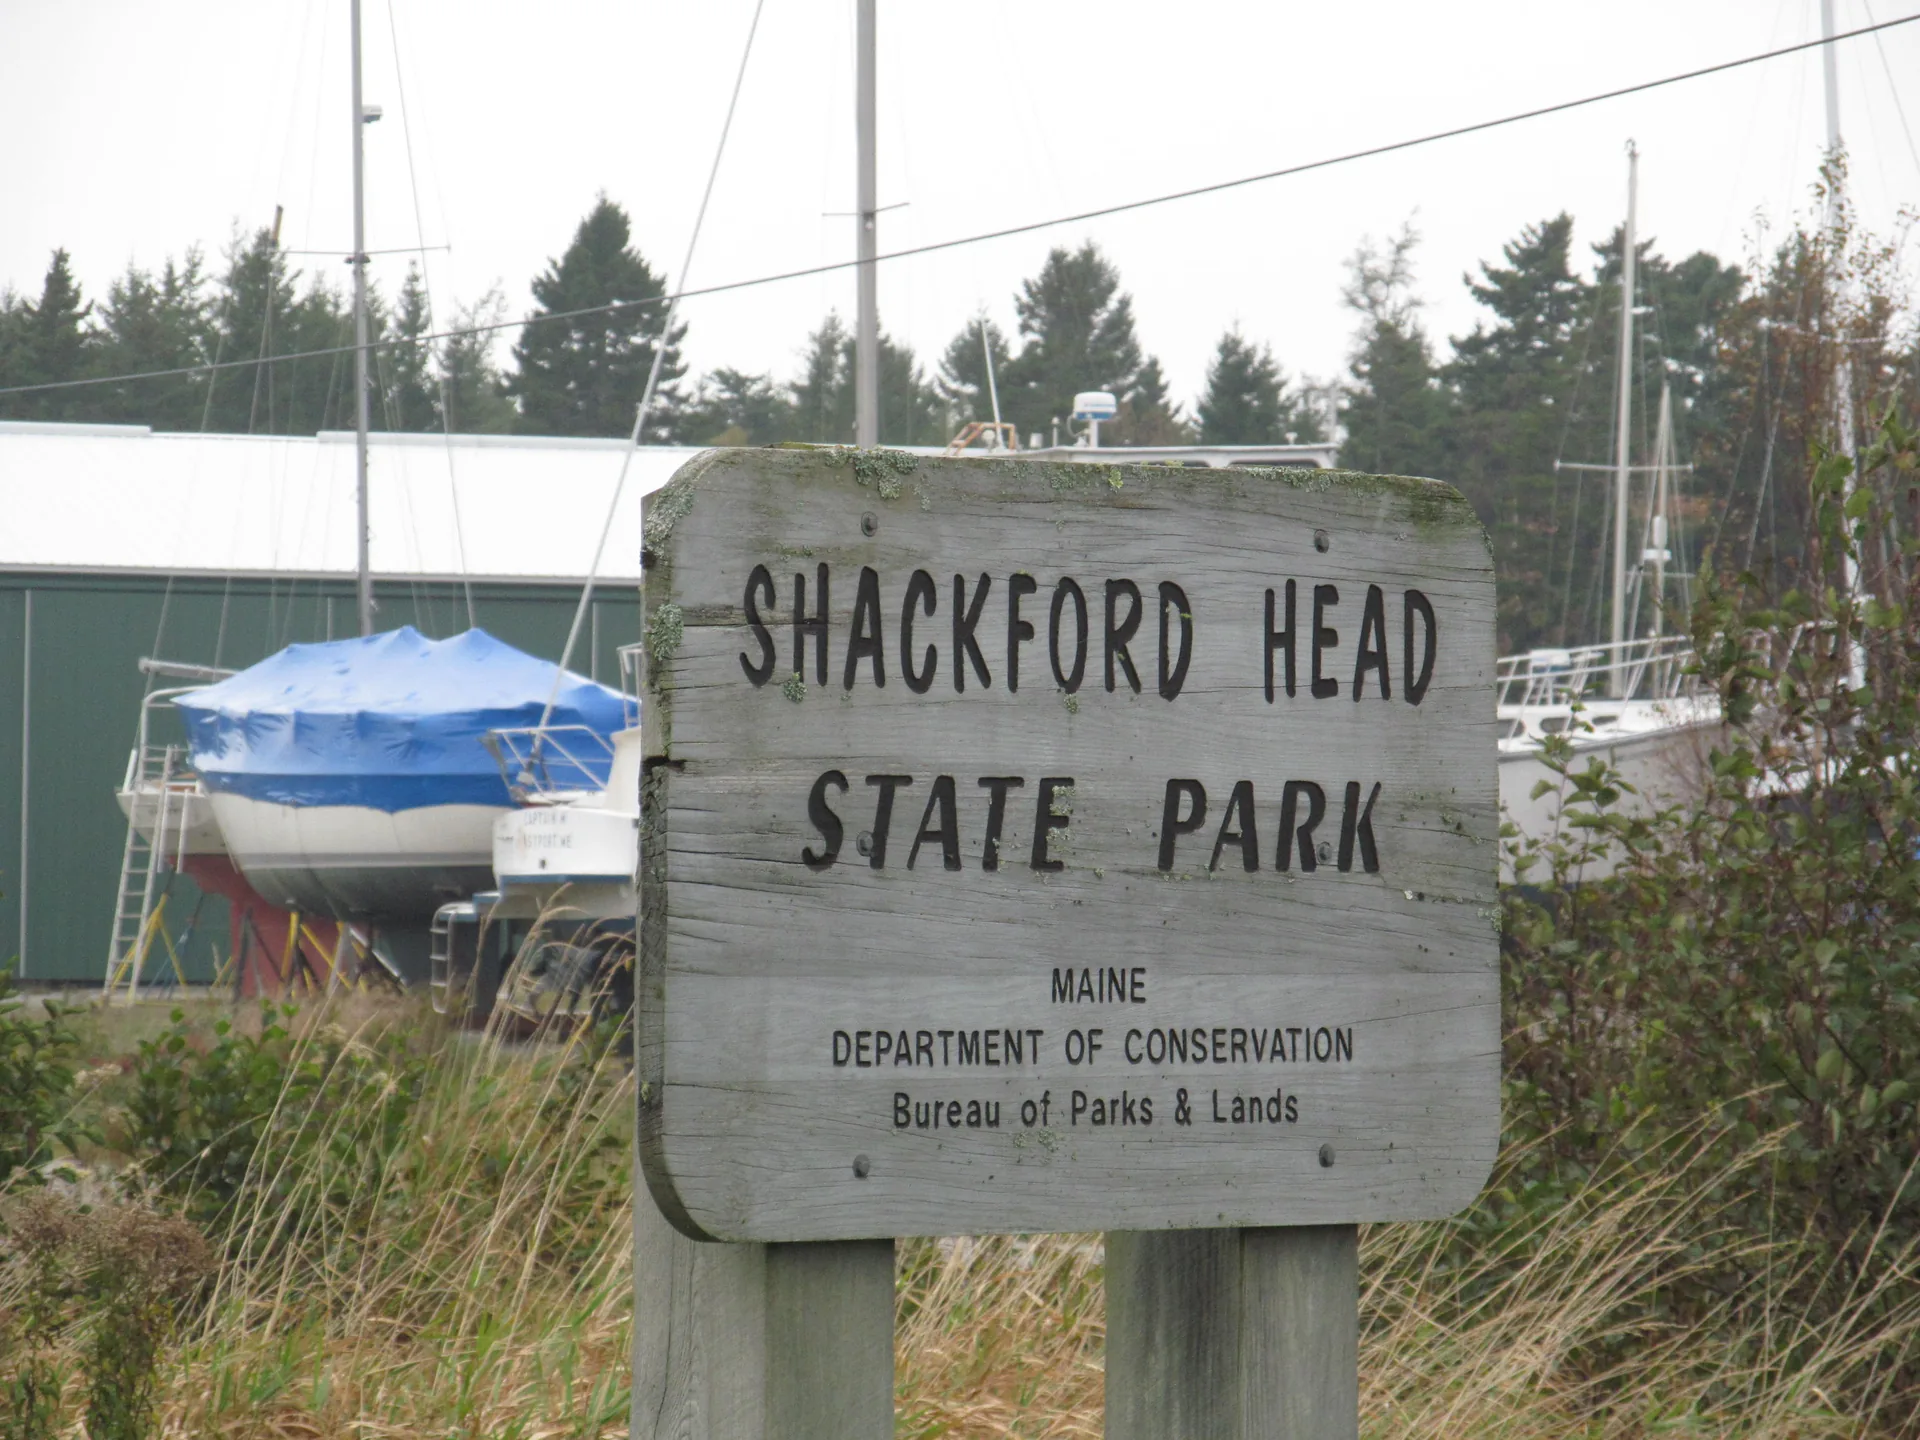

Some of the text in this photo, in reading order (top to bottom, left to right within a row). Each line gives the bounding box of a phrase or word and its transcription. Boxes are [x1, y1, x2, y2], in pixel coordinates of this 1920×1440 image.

[739, 562, 1437, 706] SHACKFORD HEAD
[802, 769, 1382, 873] STATE PARK
[1051, 967, 1147, 1003] MAINE
[832, 1026, 1353, 1067] DEPARTMENT OF CONSERVATION
[893, 1087, 1299, 1129] Bureau of Parks & Lands
